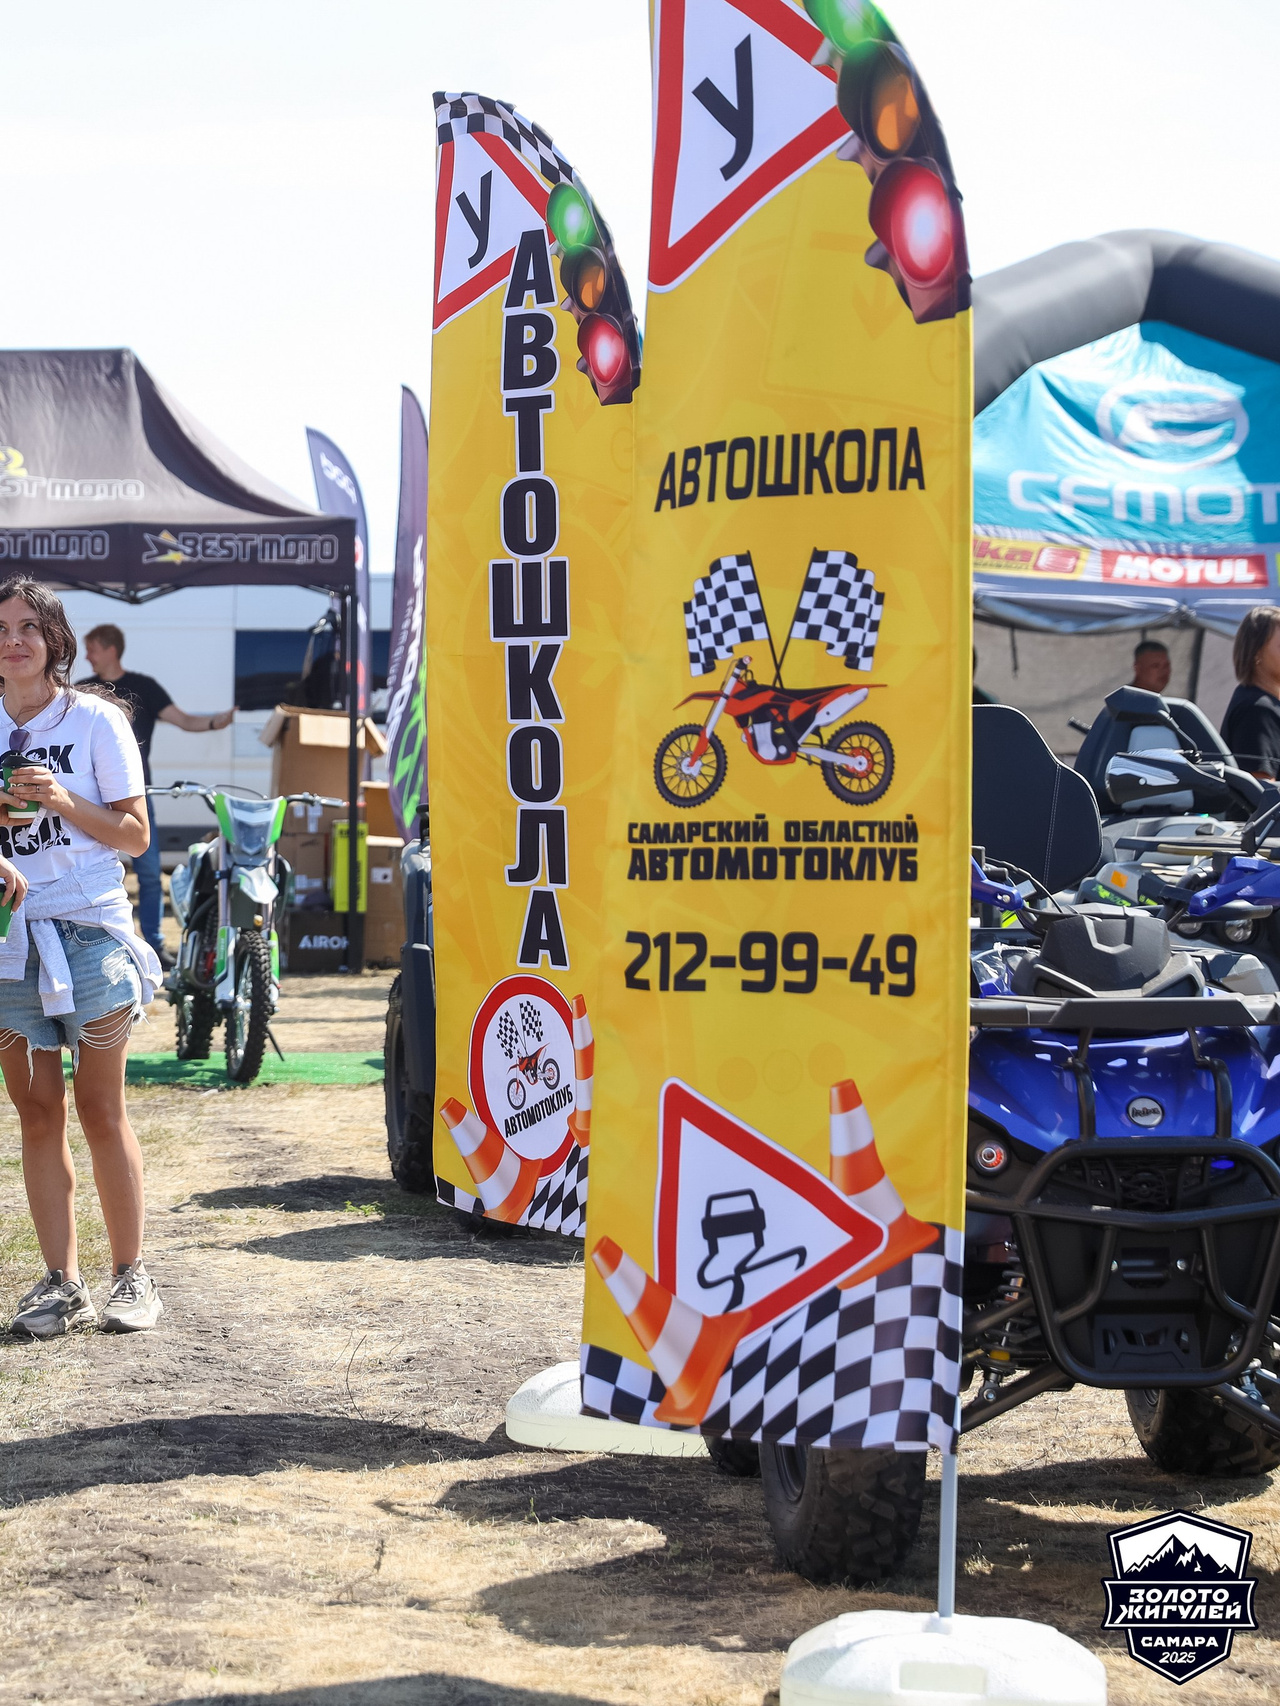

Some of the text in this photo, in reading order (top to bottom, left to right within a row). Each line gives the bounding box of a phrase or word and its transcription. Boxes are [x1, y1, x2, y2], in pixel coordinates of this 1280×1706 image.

[654, 427, 927, 513] АВТОШКОЛА
[1111, 554, 1257, 584] MOTUL
[490, 228, 569, 968] АВТОШКОЛА
[628, 814, 919, 844] САМАРСКИЙ ОБЛАСТНОЙ
[627, 846, 919, 882] АВТОМОТОКЛУБ
[624, 930, 918, 997] 212-99-49
[504, 1084, 573, 1138] АВТОМОТОКЛУБ
